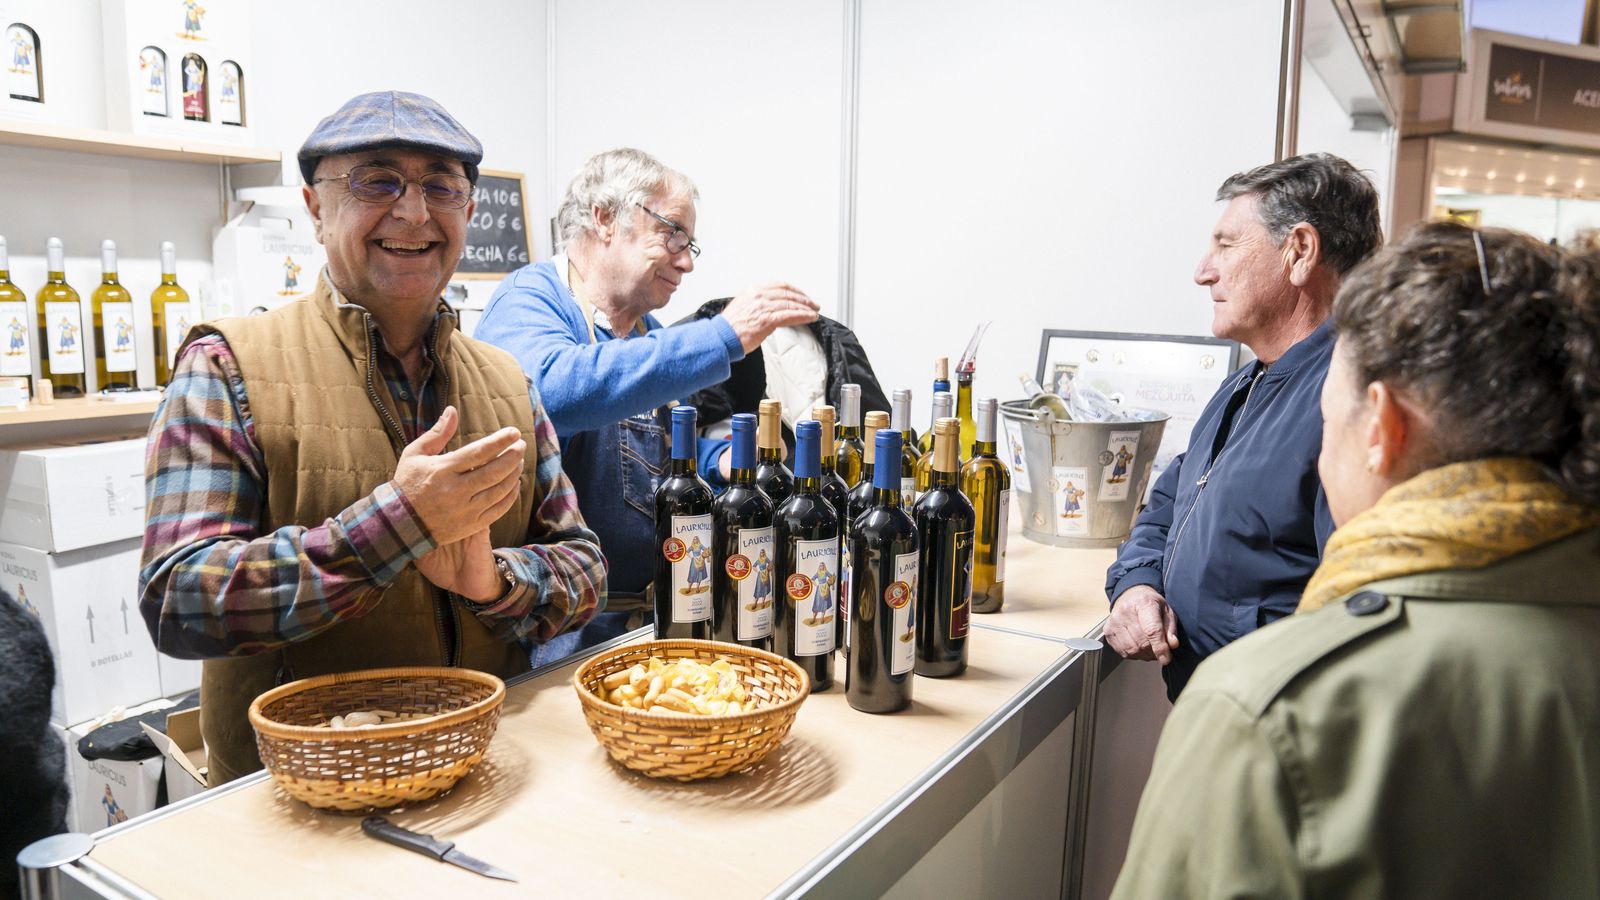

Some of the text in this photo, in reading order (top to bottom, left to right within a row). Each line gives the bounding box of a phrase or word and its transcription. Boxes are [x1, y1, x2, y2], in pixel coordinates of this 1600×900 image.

[467, 211, 494, 230] CO
[460, 244, 504, 263] ECHA
[1135, 389, 1197, 403] MEZQUITA
